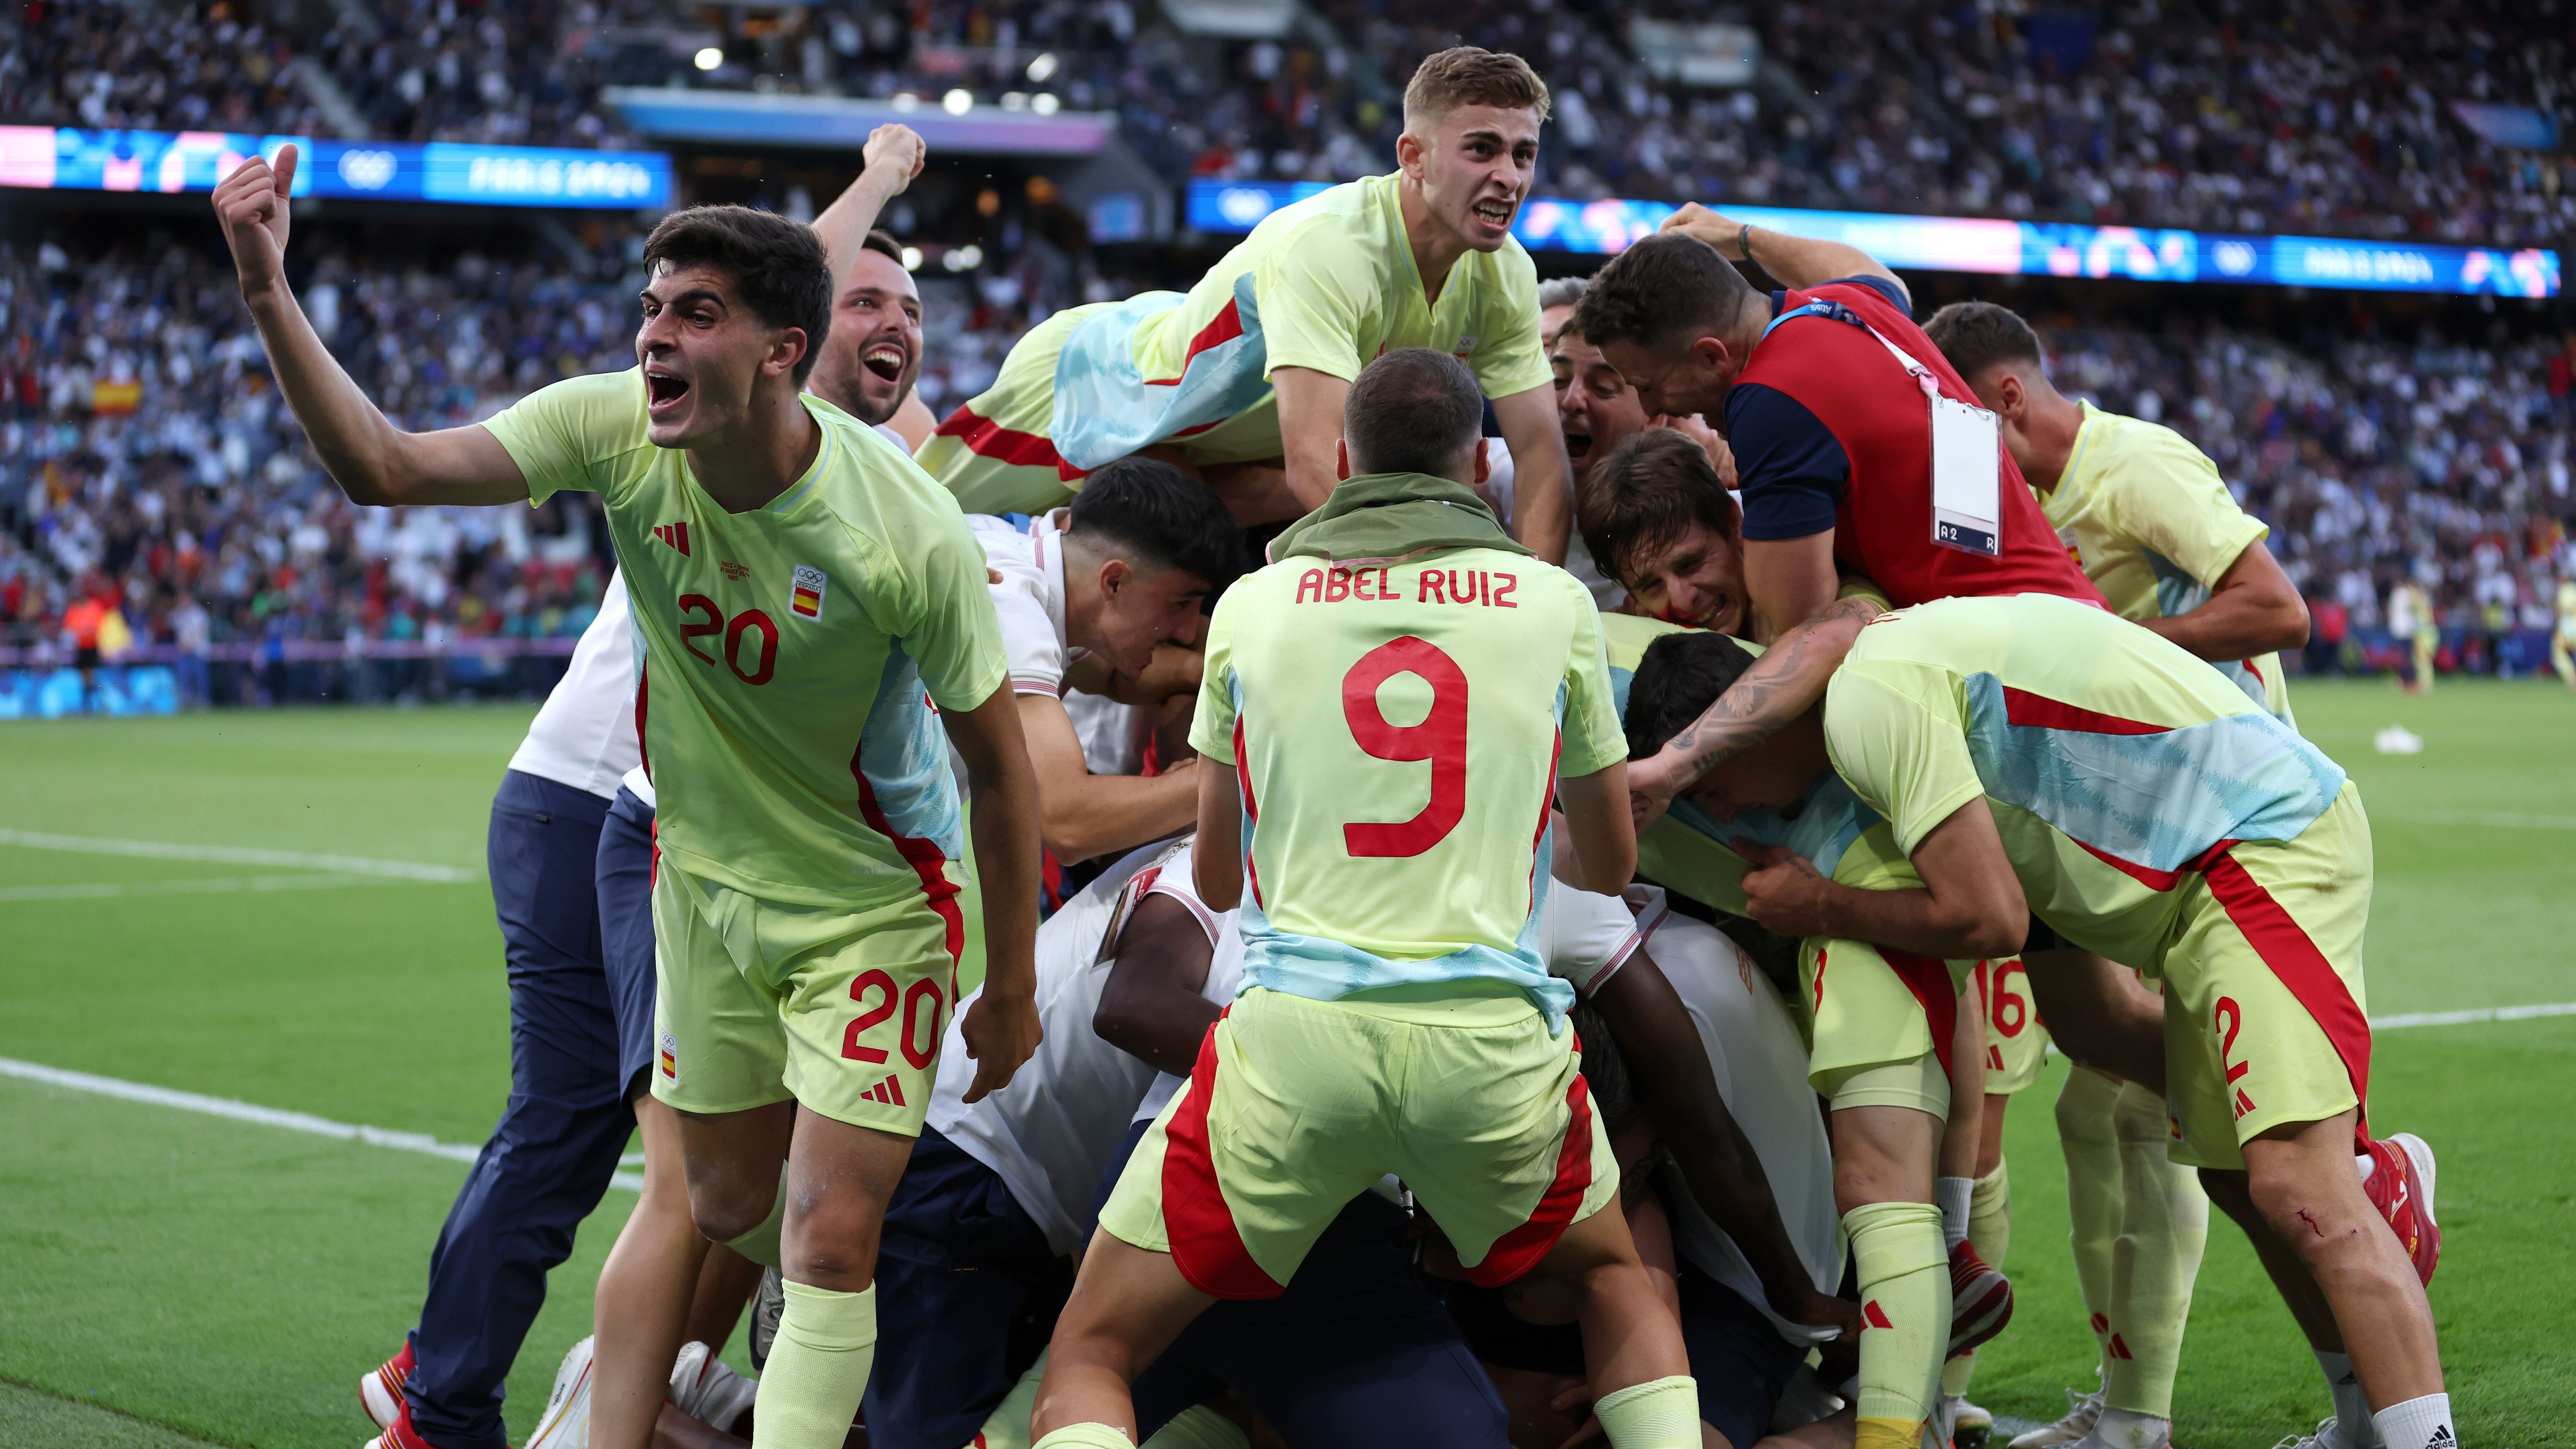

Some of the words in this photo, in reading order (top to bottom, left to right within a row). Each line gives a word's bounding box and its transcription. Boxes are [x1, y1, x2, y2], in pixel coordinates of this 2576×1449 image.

[1810, 304, 1832, 313] Atos
[1987, 536, 1994, 550] R
[1295, 567, 1401, 604] ABEL
[1418, 569, 1517, 608] RUIZ
[678, 593, 779, 686] 20
[1342, 635, 1468, 857] 9
[840, 968, 944, 1070] 20
[2215, 997, 2249, 1085] 2
